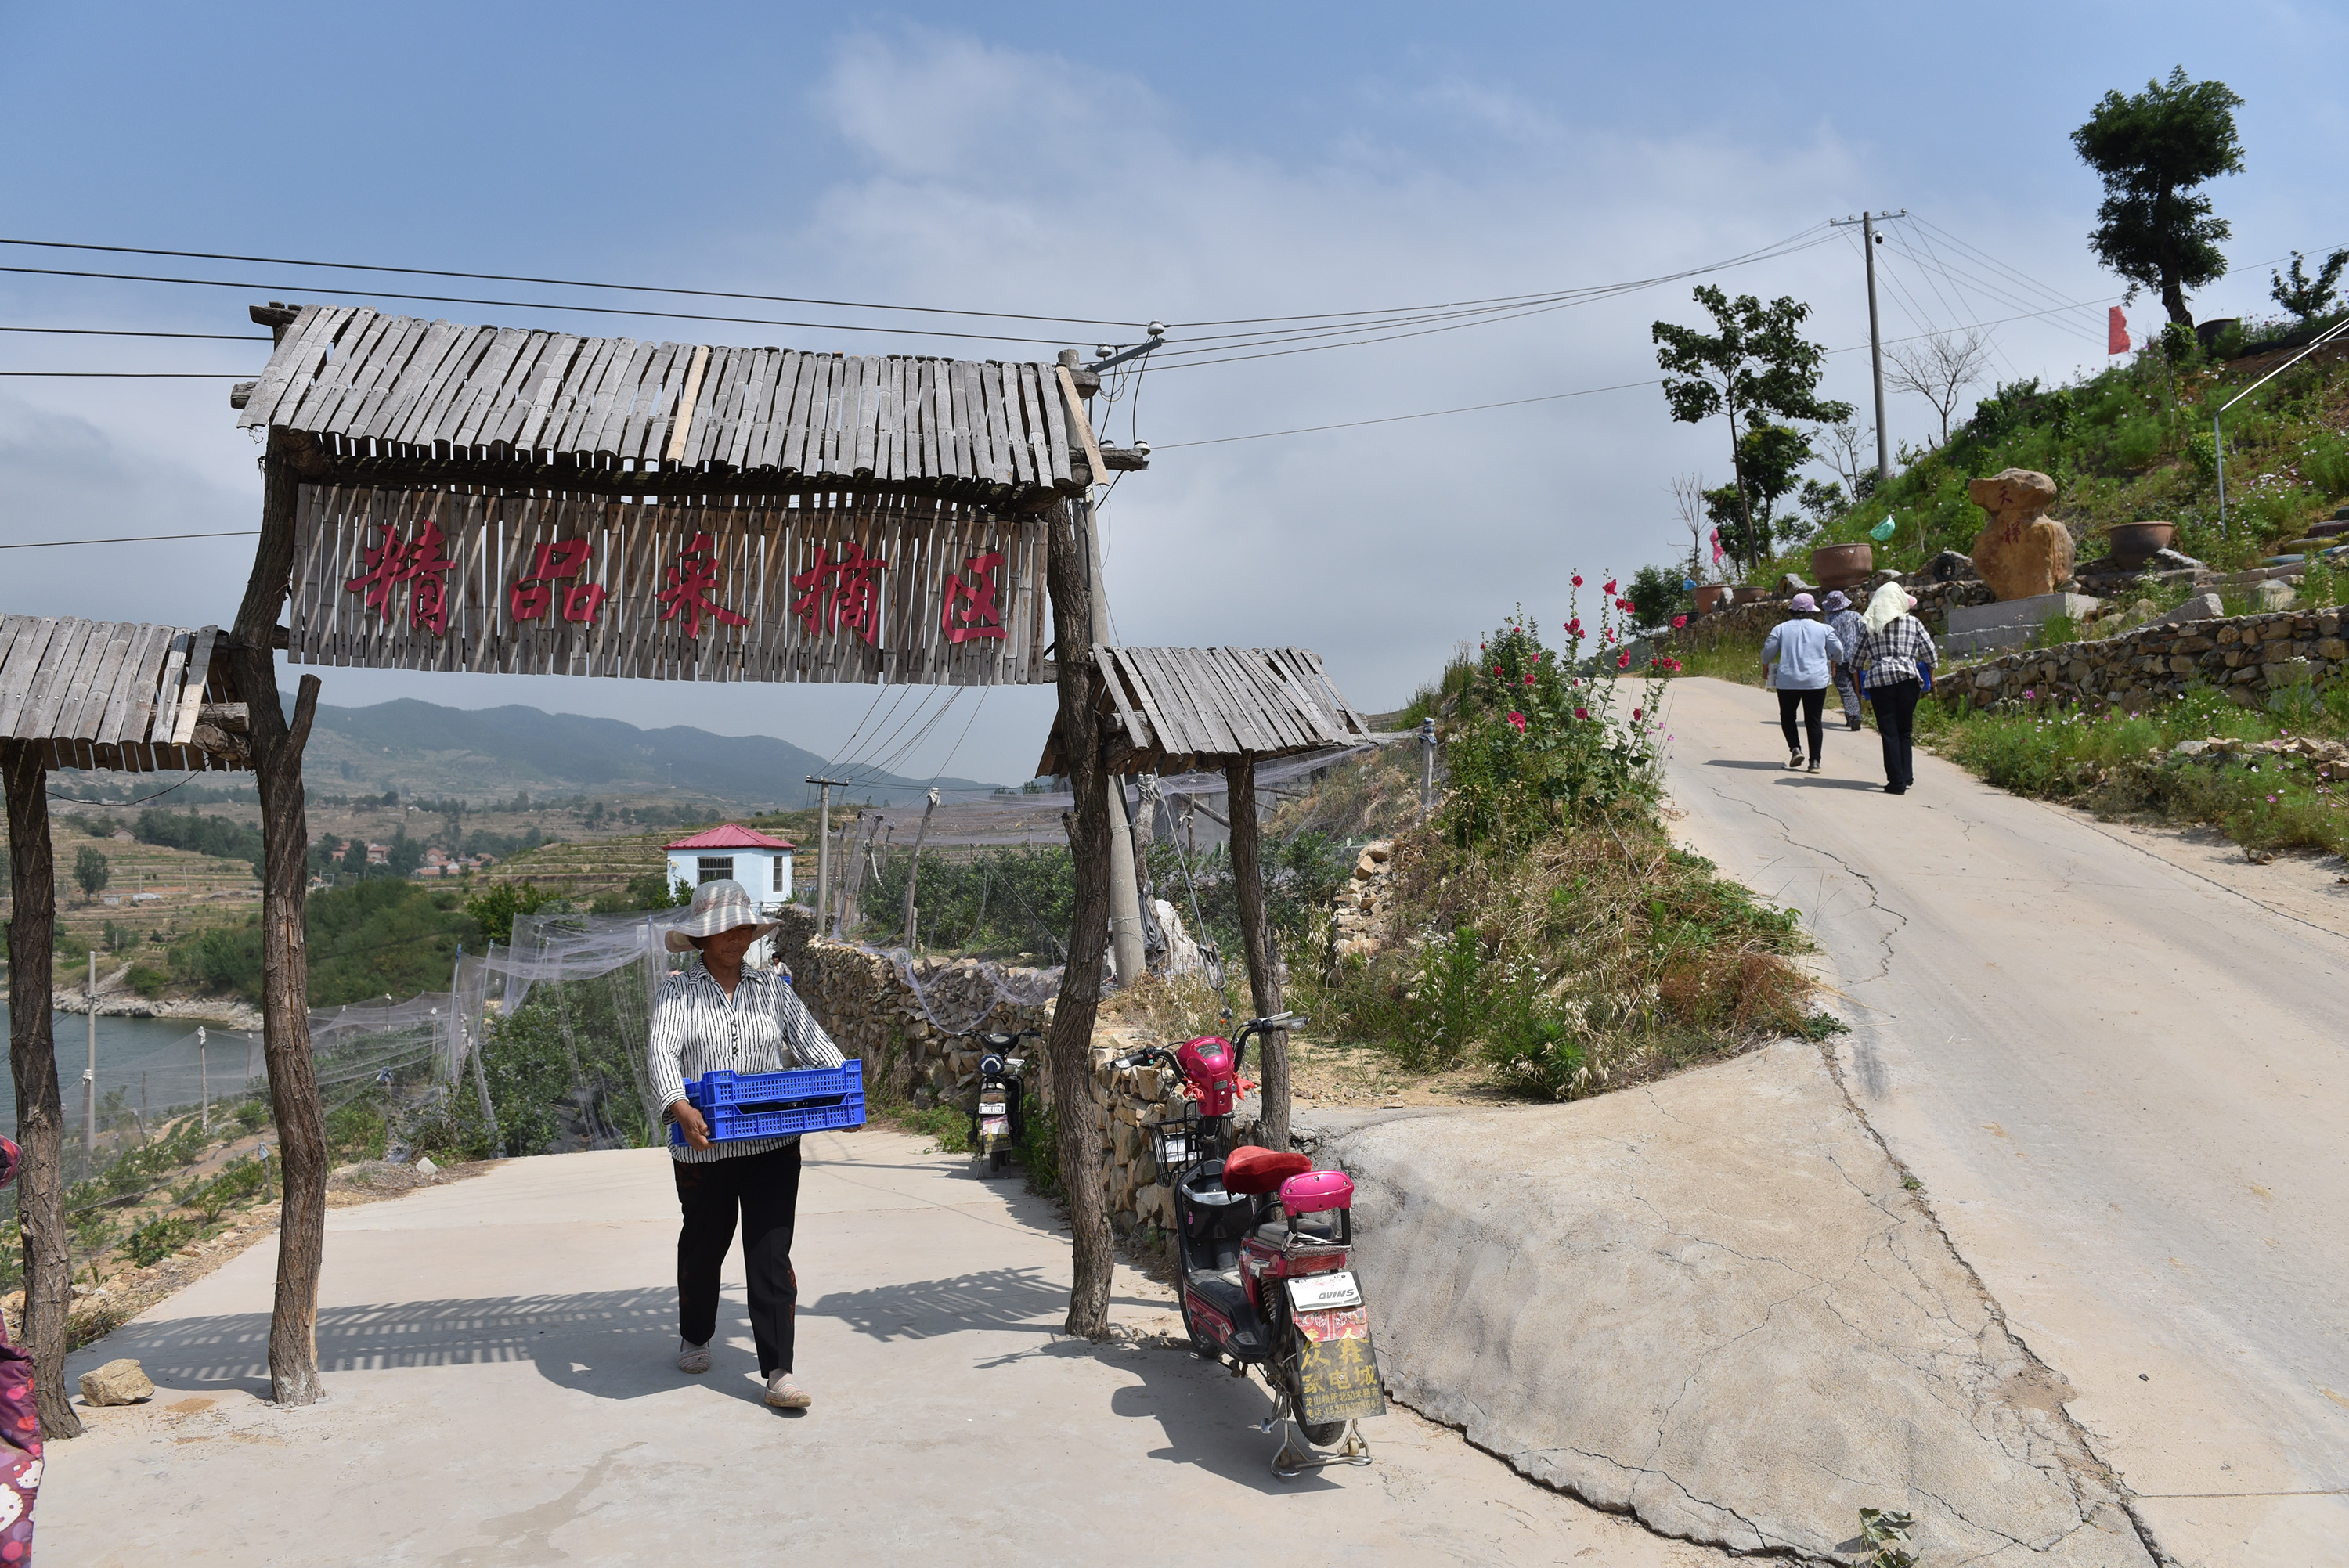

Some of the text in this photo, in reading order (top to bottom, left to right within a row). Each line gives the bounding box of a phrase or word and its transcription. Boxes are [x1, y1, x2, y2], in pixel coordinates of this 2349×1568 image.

[346, 519, 1009, 648] 精品采摘区
[1301, 1365, 1378, 1394] 家电城
